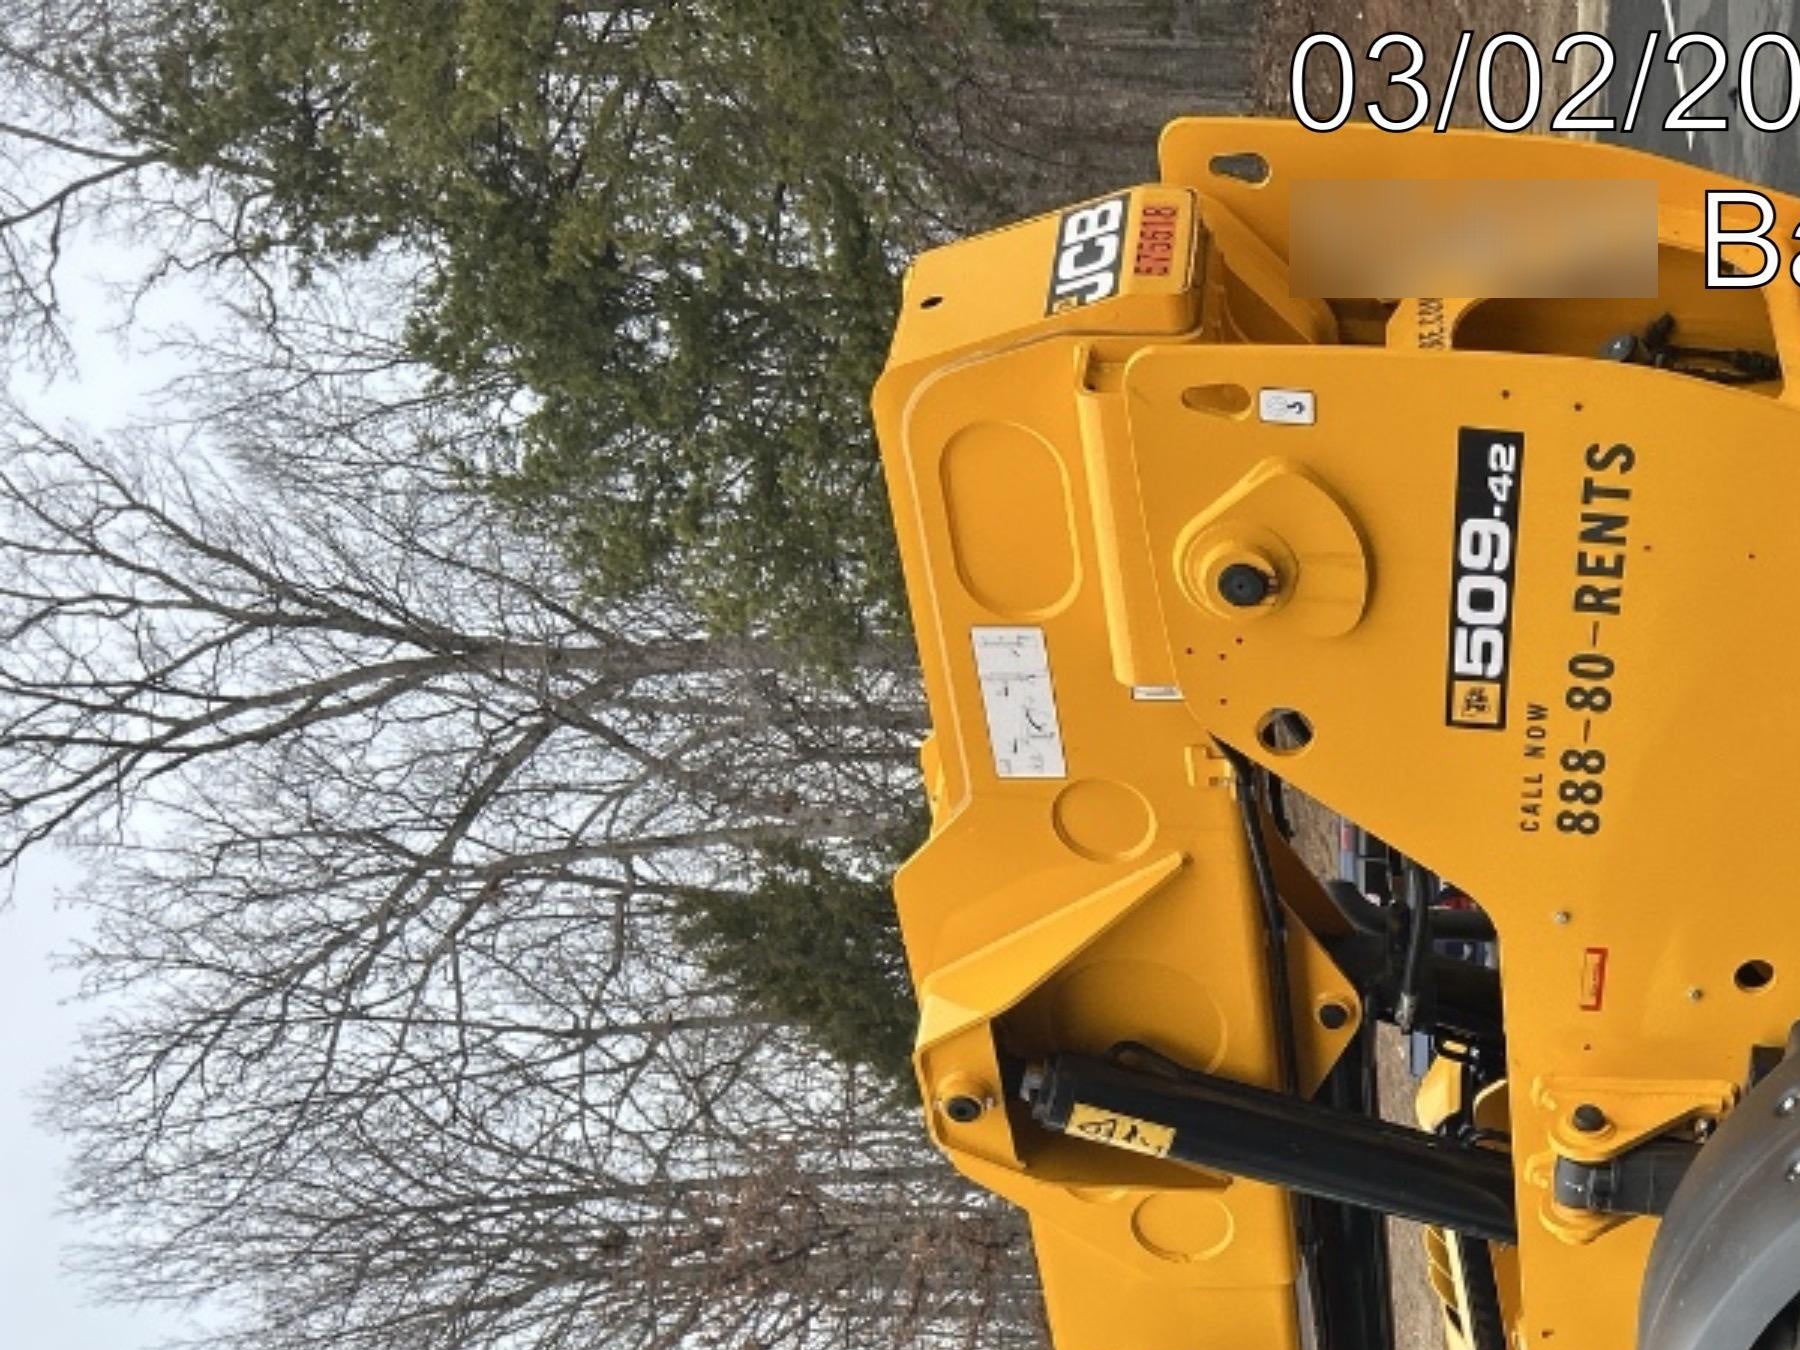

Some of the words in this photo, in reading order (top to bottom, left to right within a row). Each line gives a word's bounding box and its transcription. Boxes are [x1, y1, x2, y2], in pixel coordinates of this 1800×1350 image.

[1055, 198, 1123, 303] JCB
[1555, 441, 1636, 836] 888-80-RENTS
[1522, 700, 1549, 760] NOW
[1519, 771, 1544, 832] CALL
